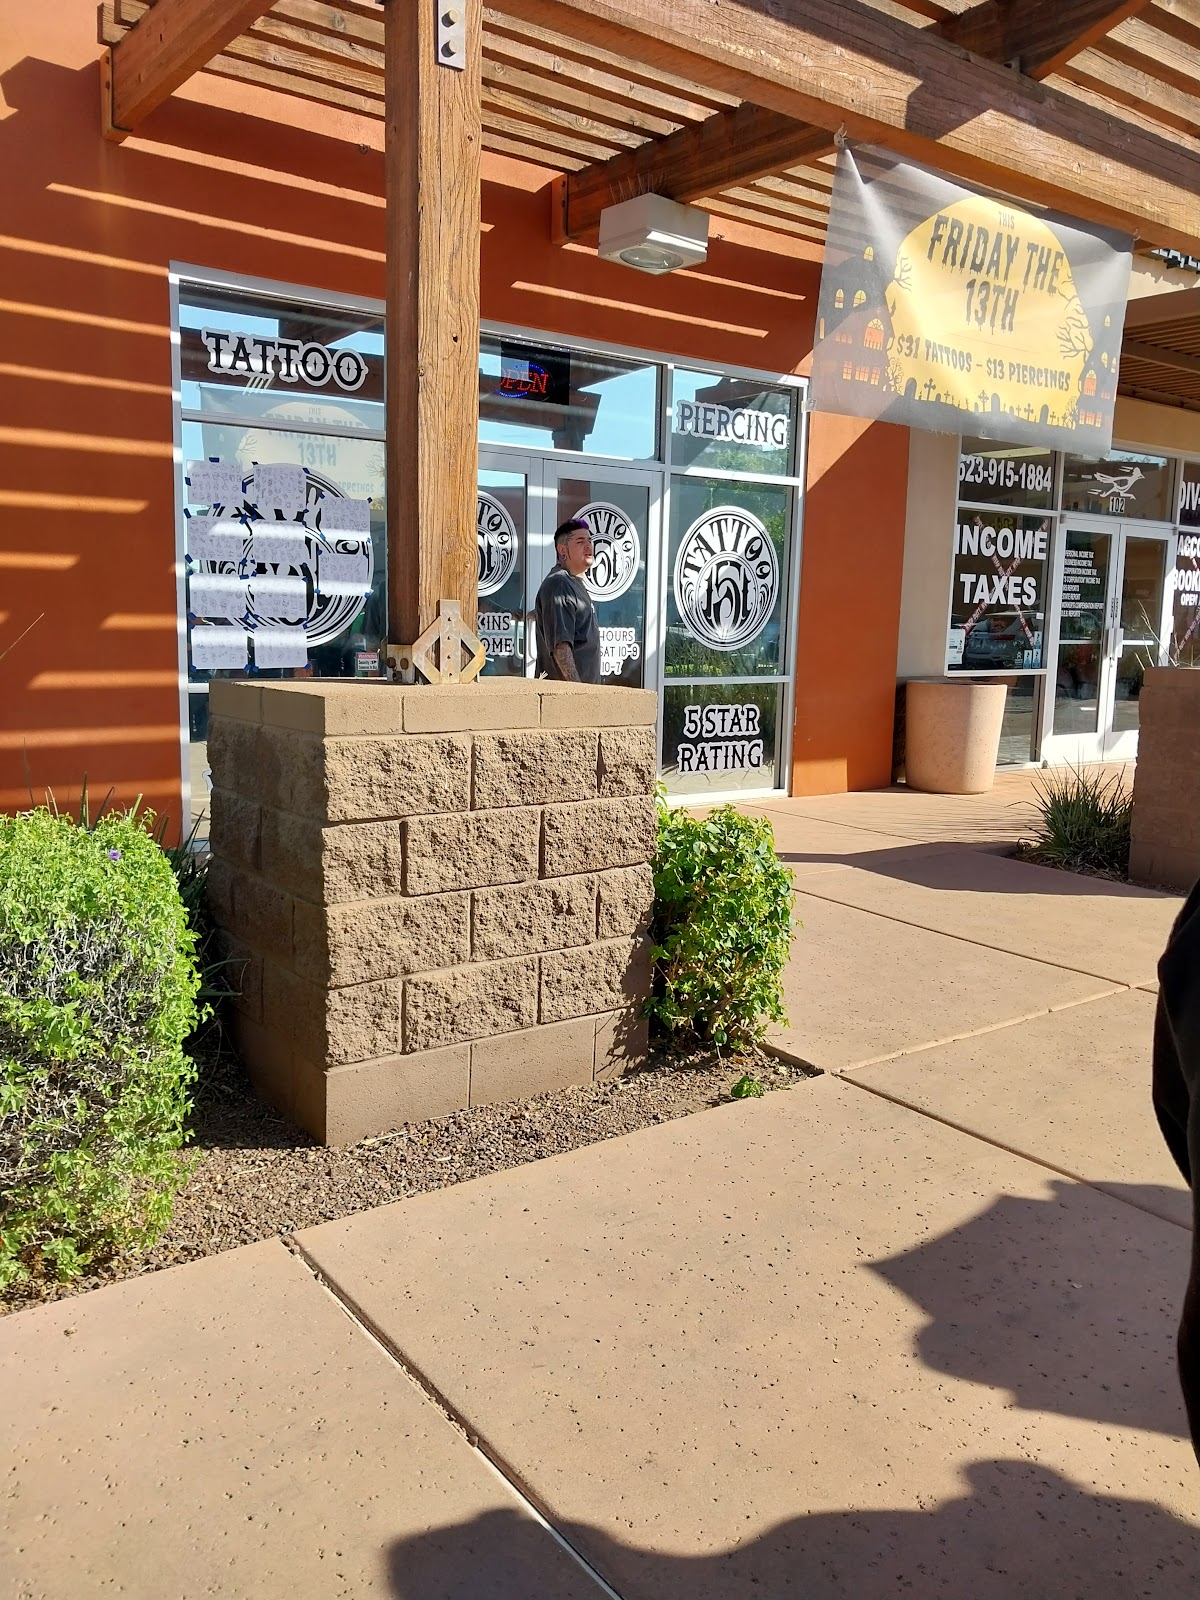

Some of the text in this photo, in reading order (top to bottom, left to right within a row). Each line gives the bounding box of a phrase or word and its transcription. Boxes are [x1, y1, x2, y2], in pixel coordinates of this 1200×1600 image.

[999, 211, 1015, 230] THIS
[927, 214, 1064, 295] FRIDAY THE
[966, 278, 1020, 333] 13TH
[204, 330, 364, 388] TATTOO
[897, 333, 920, 359] $31
[925, 339, 972, 373] TATTOOS
[986, 357, 1005, 380] $13
[1008, 361, 1071, 392] PIERCINGS
[679, 402, 785, 446] PIERCING
[1111, 497, 1125, 513] 102
[683, 518, 771, 580] TATTOO
[954, 524, 1048, 560] INCOME
[960, 573, 1037, 606] TAXES
[600, 630, 634, 641] HOURS
[619, 646, 638, 657] 10-9
[602, 661, 621, 673] 10-7
[685, 707, 758, 735] 5 STAR
[679, 742, 762, 773] RATING
